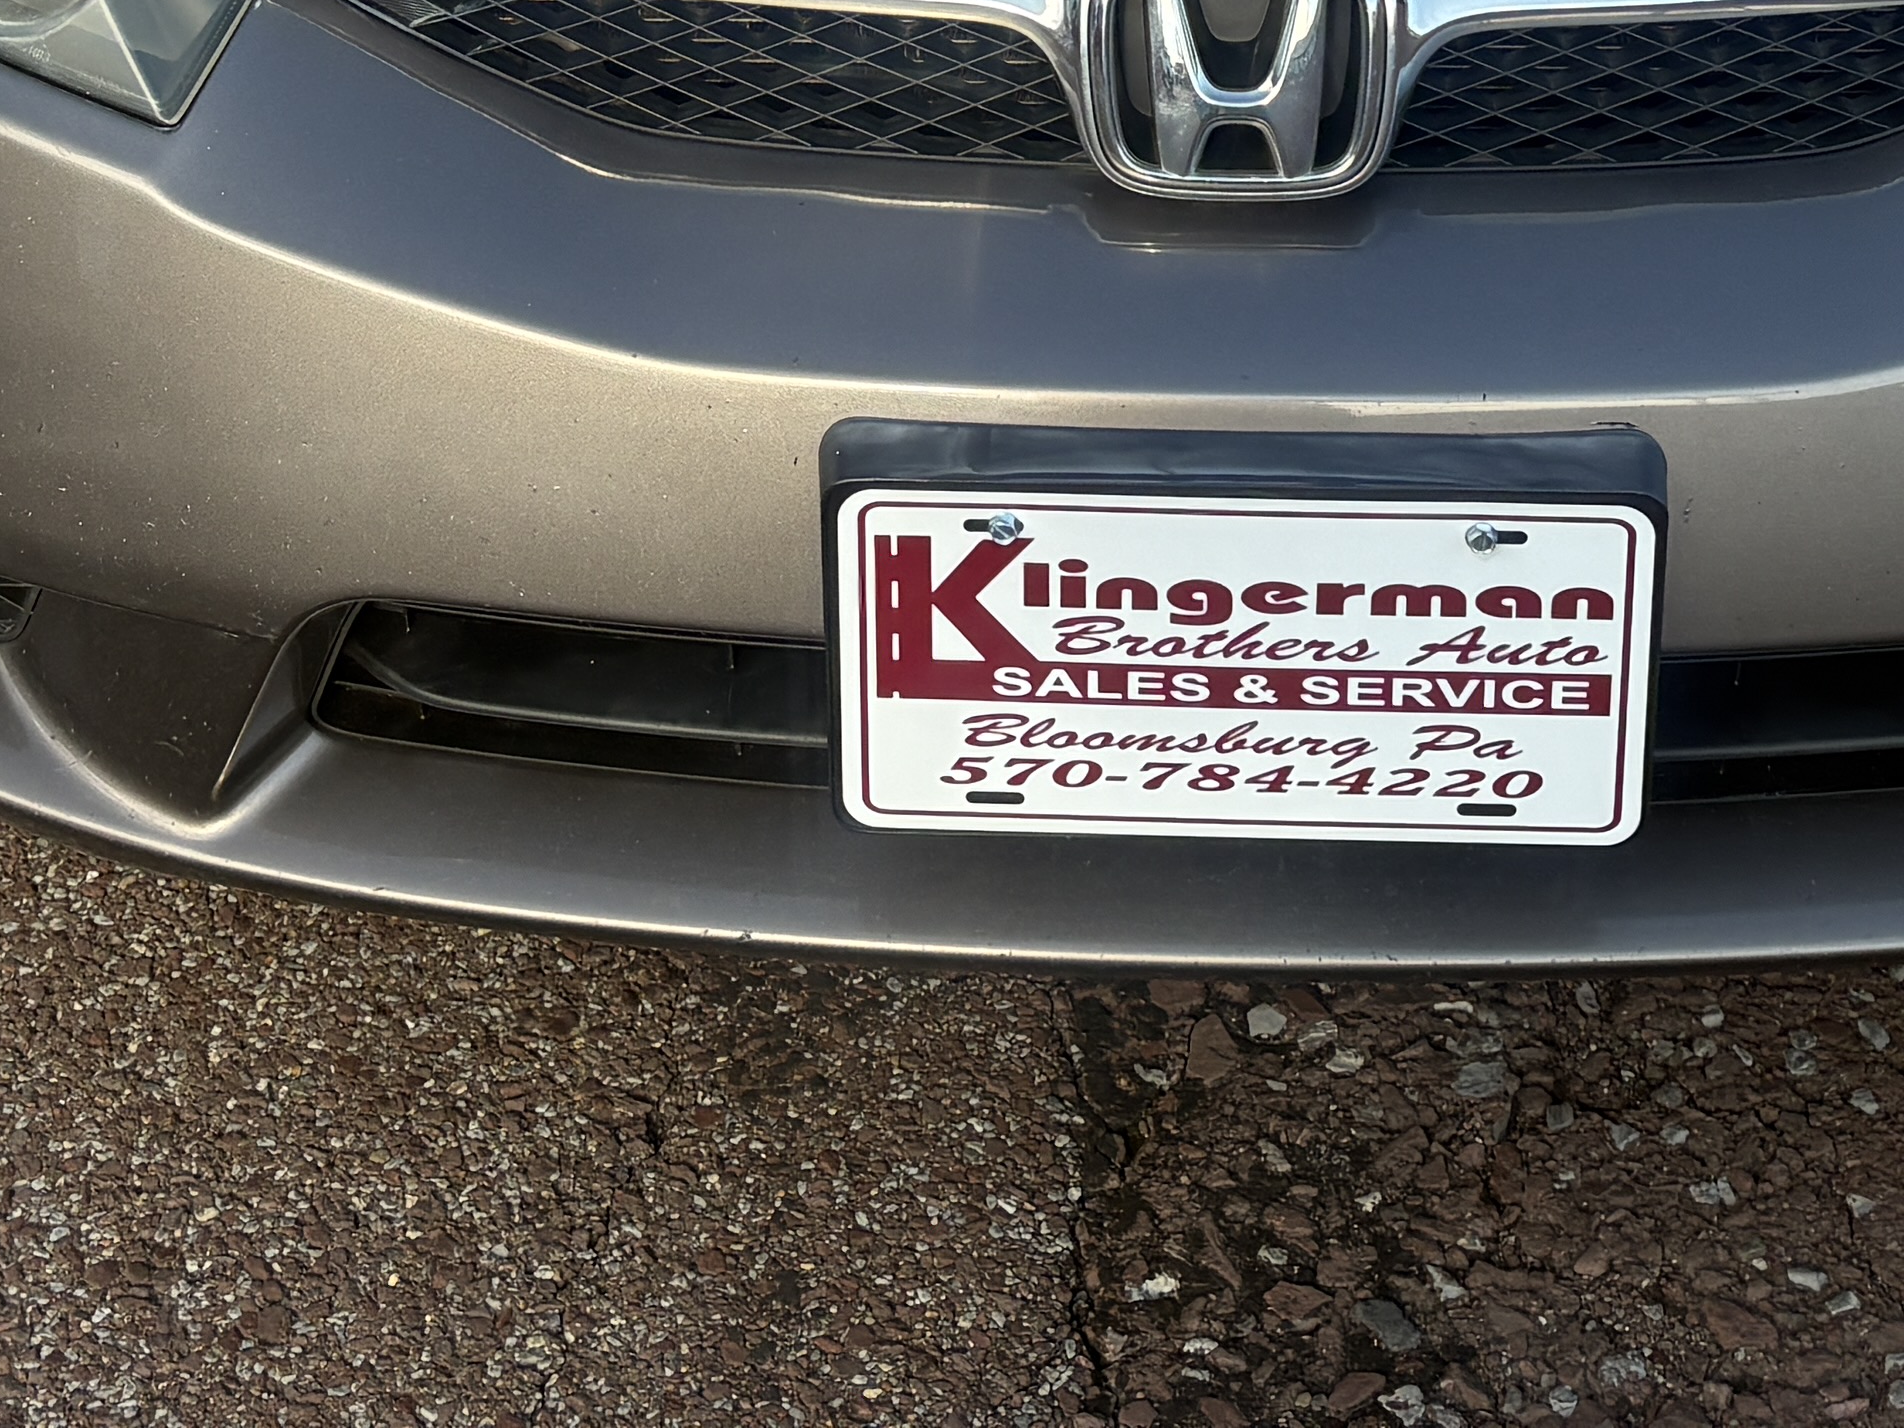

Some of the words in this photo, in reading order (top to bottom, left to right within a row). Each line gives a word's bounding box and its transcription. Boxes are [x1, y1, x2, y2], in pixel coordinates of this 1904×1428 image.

[875, 535, 1614, 686] Klingerman
[1053, 615, 1380, 664] Brothers
[1406, 626, 1609, 669] Auto
[992, 666, 1210, 702] SALES
[1234, 672, 1279, 705] &
[1301, 674, 1591, 711] SERVICE
[962, 713, 1378, 764] Bloomsburg
[1409, 724, 1521, 761] Pa
[939, 756, 1545, 800] 570-784-4220
